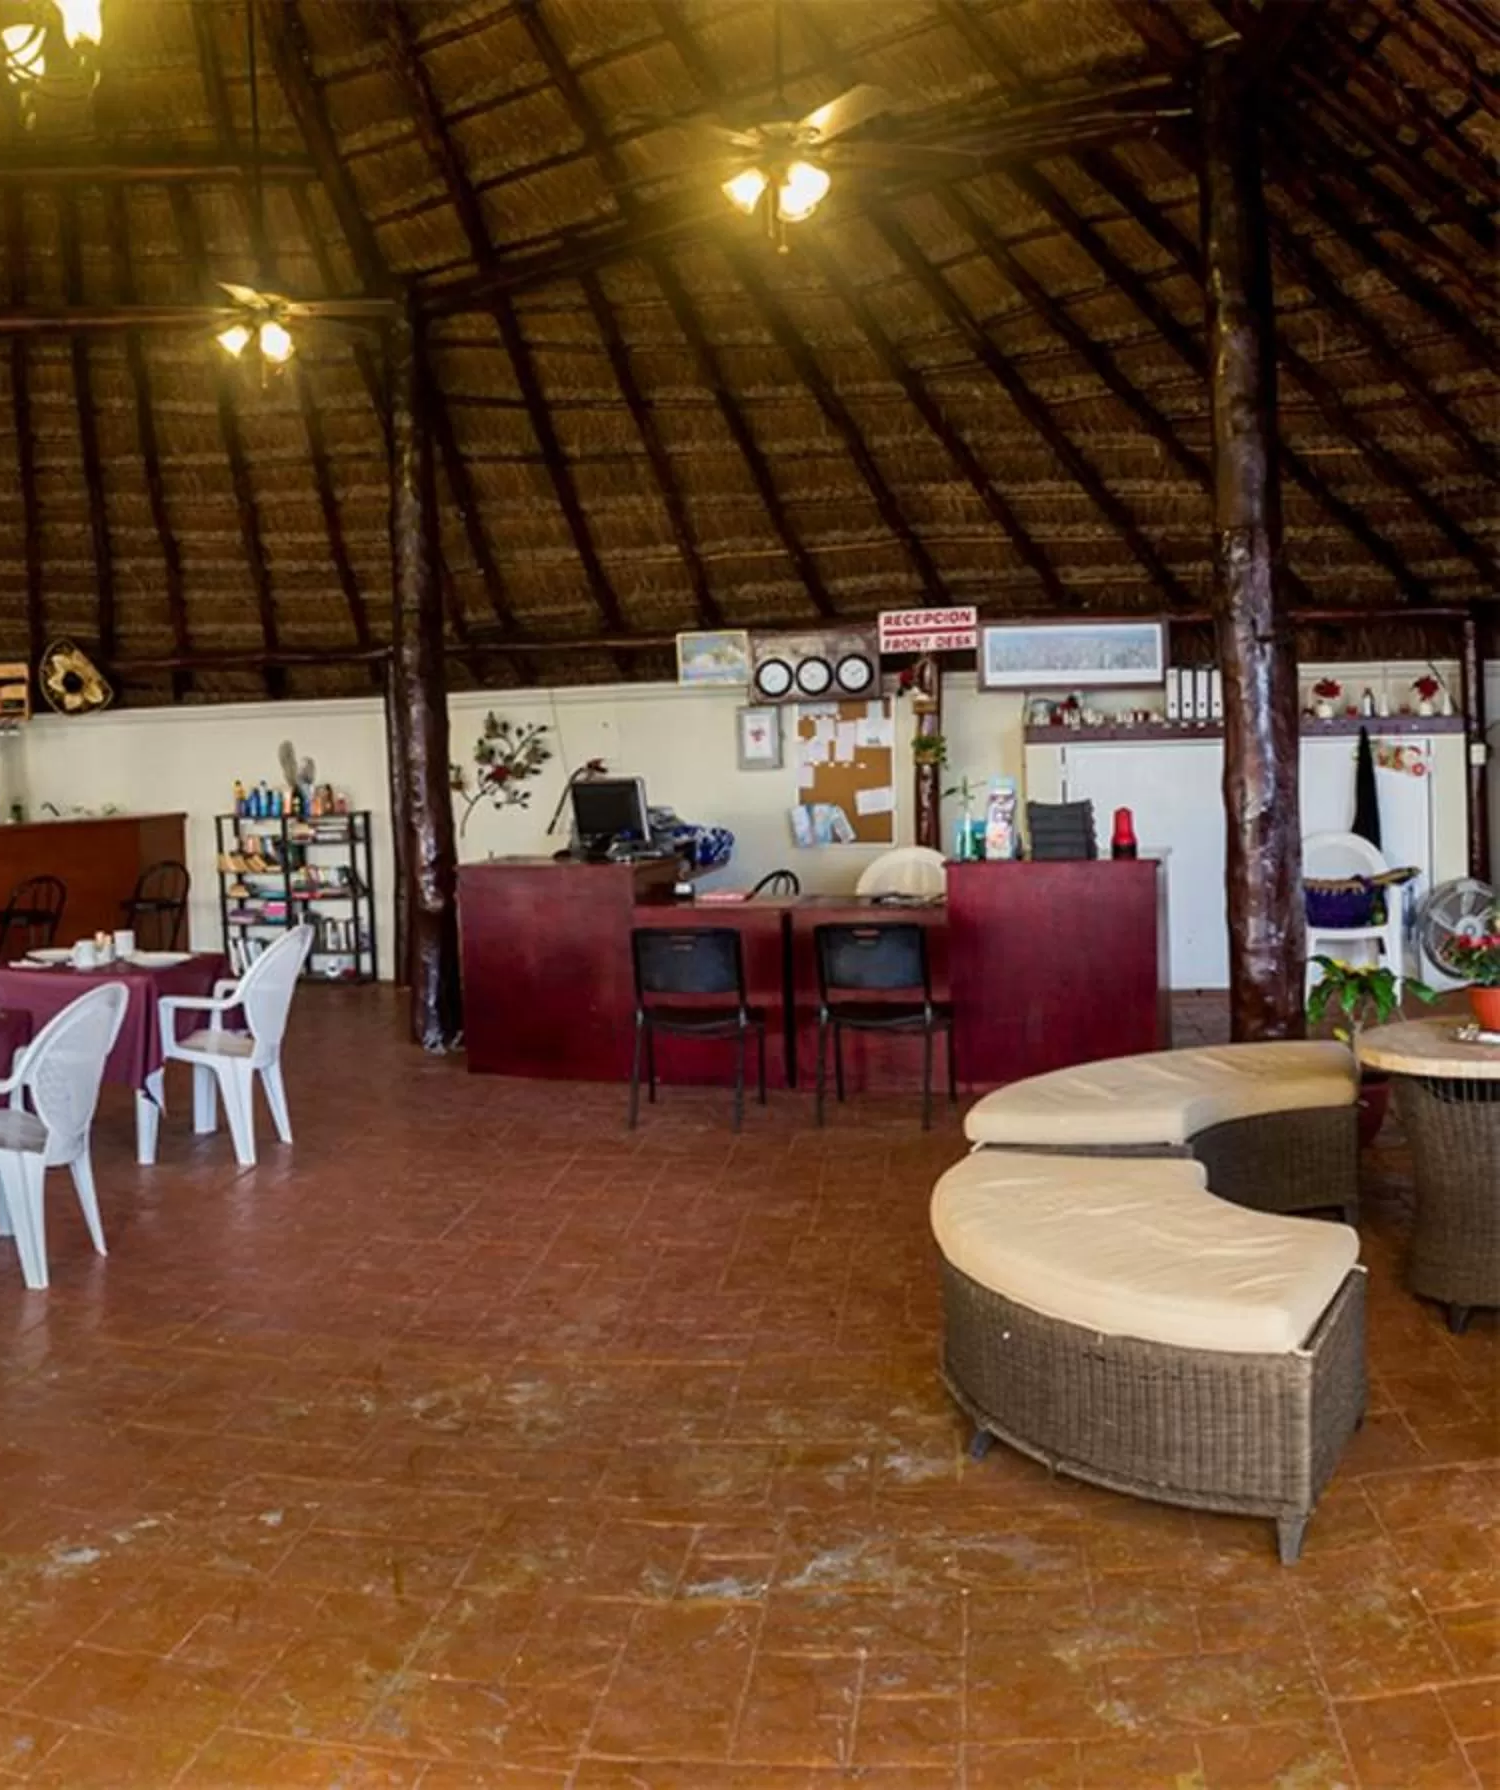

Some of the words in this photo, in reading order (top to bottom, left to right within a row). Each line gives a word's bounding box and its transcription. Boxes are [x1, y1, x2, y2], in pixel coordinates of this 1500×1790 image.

[883, 611, 971, 626] RECEPCION
[883, 637, 930, 650] FRONT
[934, 635, 971, 648] DESK
